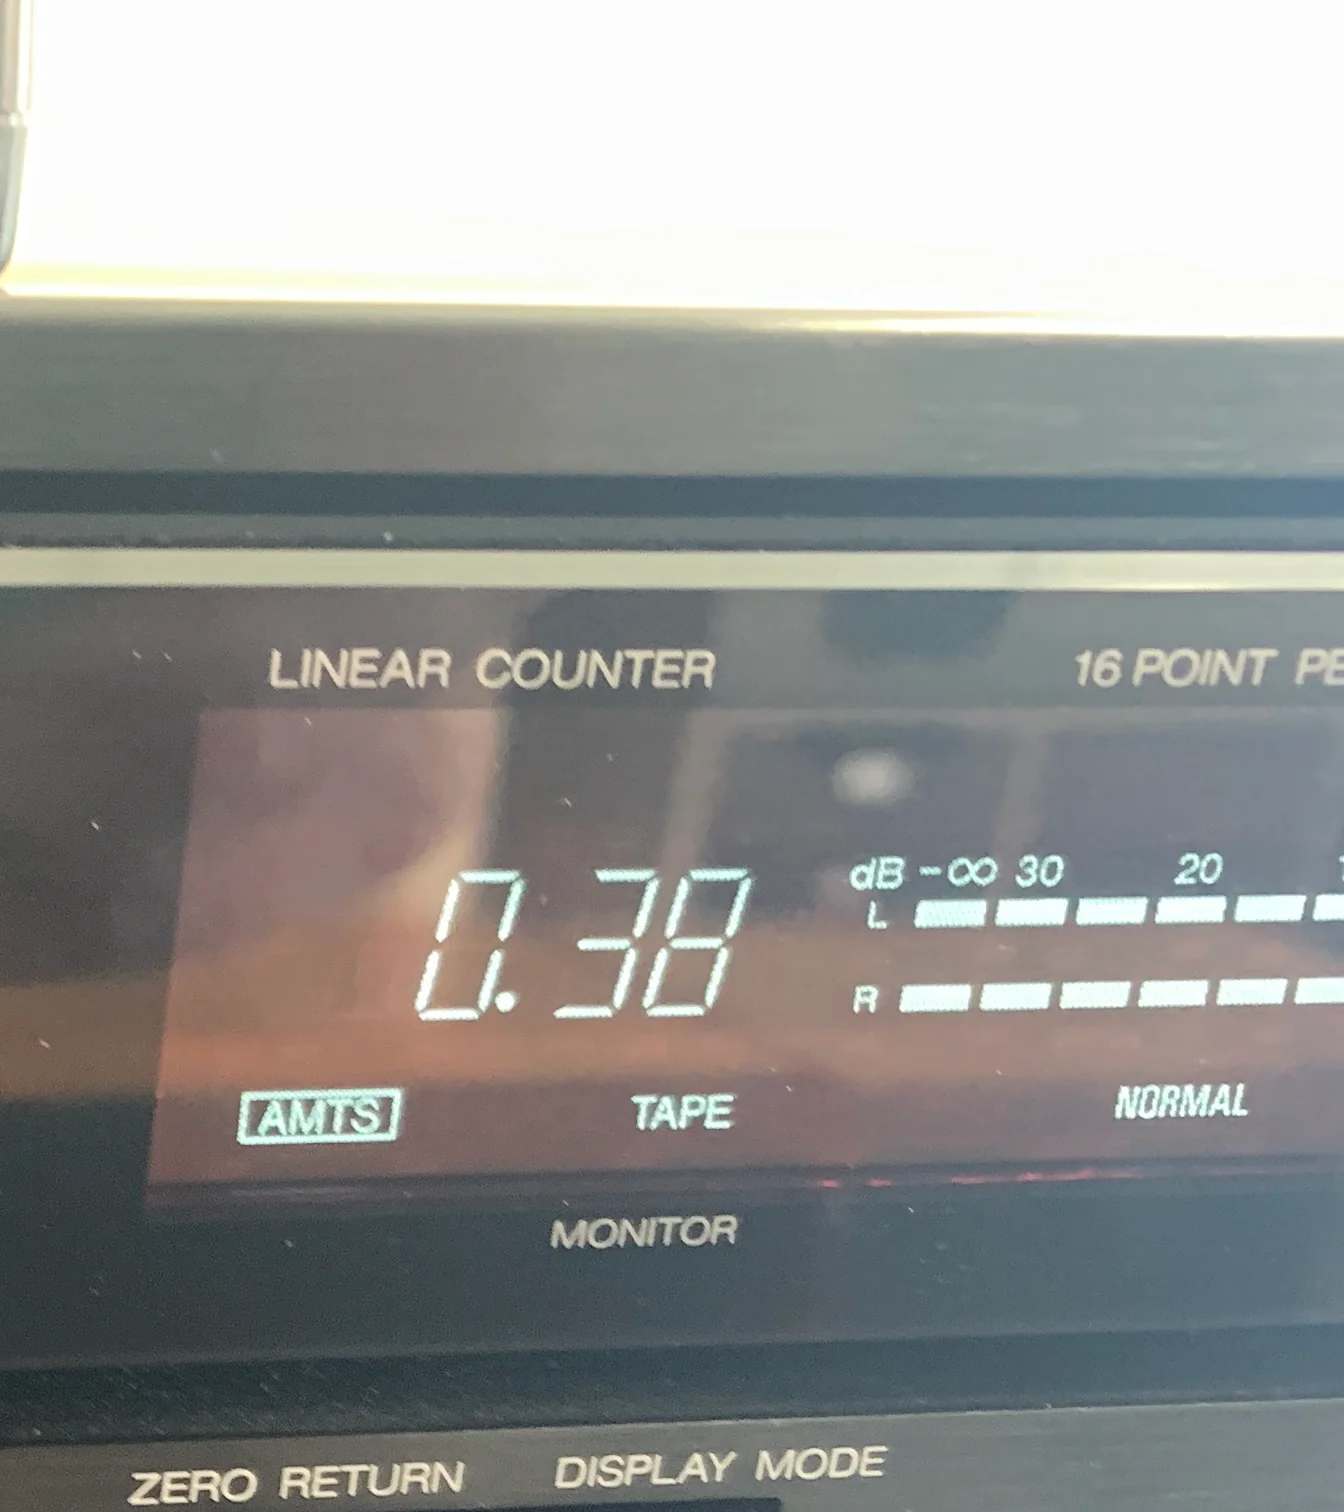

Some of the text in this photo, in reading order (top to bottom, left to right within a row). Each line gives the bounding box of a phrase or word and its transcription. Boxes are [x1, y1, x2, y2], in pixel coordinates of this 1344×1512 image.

[270, 647, 717, 690] LINEAR COUNTER
[1076, 648, 1123, 687] 16
[1132, 648, 1280, 687] POINT
[849, 856, 906, 892] dB
[1015, 854, 1065, 888] 30
[1173, 852, 1223, 885] 20
[867, 900, 888, 930] L
[853, 985, 879, 1014] R
[257, 1102, 384, 1136] AMTS
[630, 1093, 735, 1131] TAPE
[1114, 1082, 1249, 1120] NORMAL
[550, 1214, 738, 1249] MONITOR
[127, 1461, 465, 1506] ZERO RETURN
[554, 1445, 889, 1489] DISPLAY MODE
